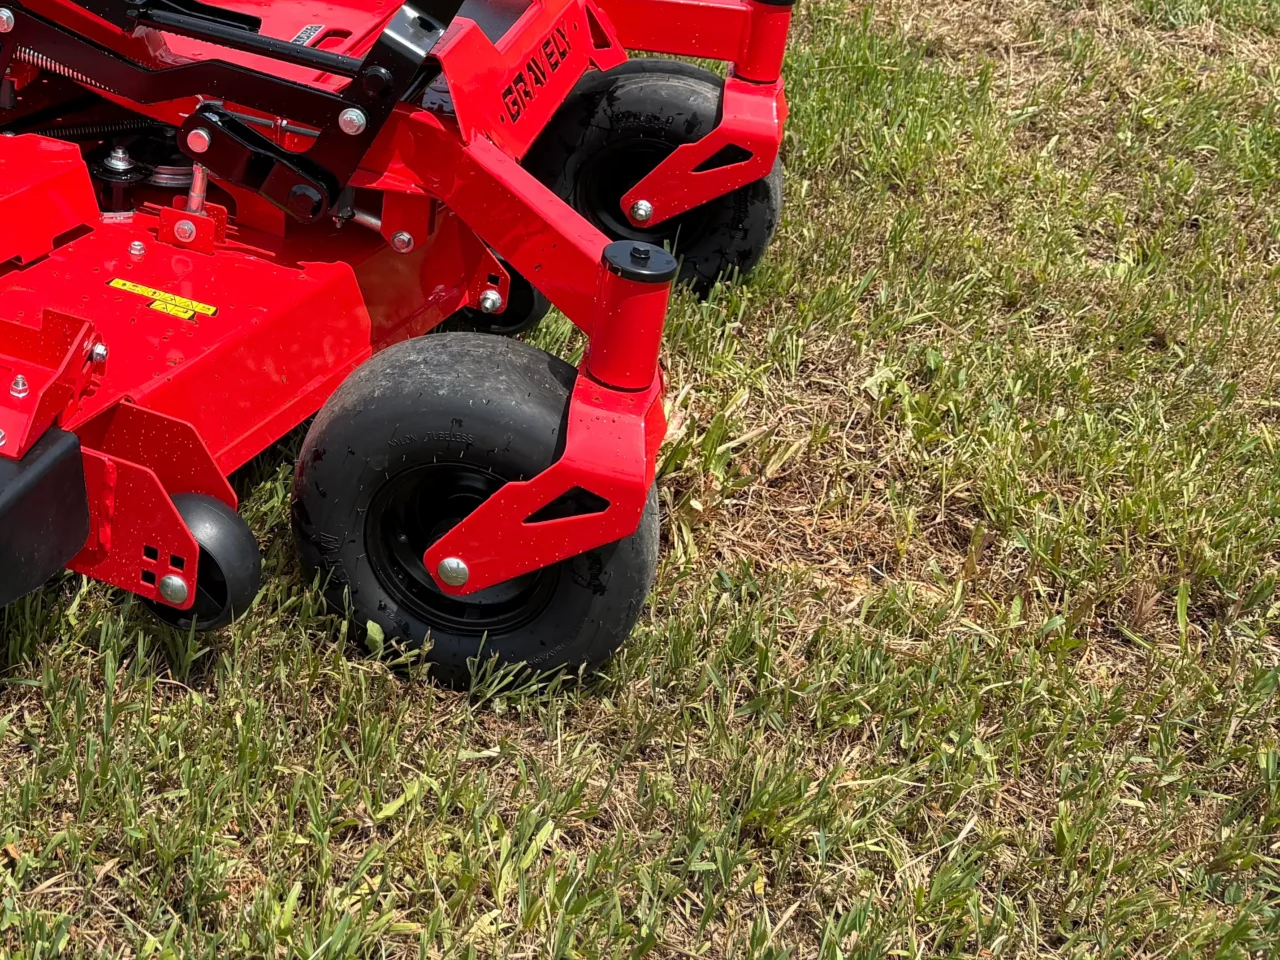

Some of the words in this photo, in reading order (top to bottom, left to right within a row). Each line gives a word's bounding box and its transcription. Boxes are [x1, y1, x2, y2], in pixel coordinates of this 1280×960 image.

[502, 19, 573, 124] GRAVELY
[387, 433, 418, 449] NYLON
[424, 431, 475, 445] TUBELESS
